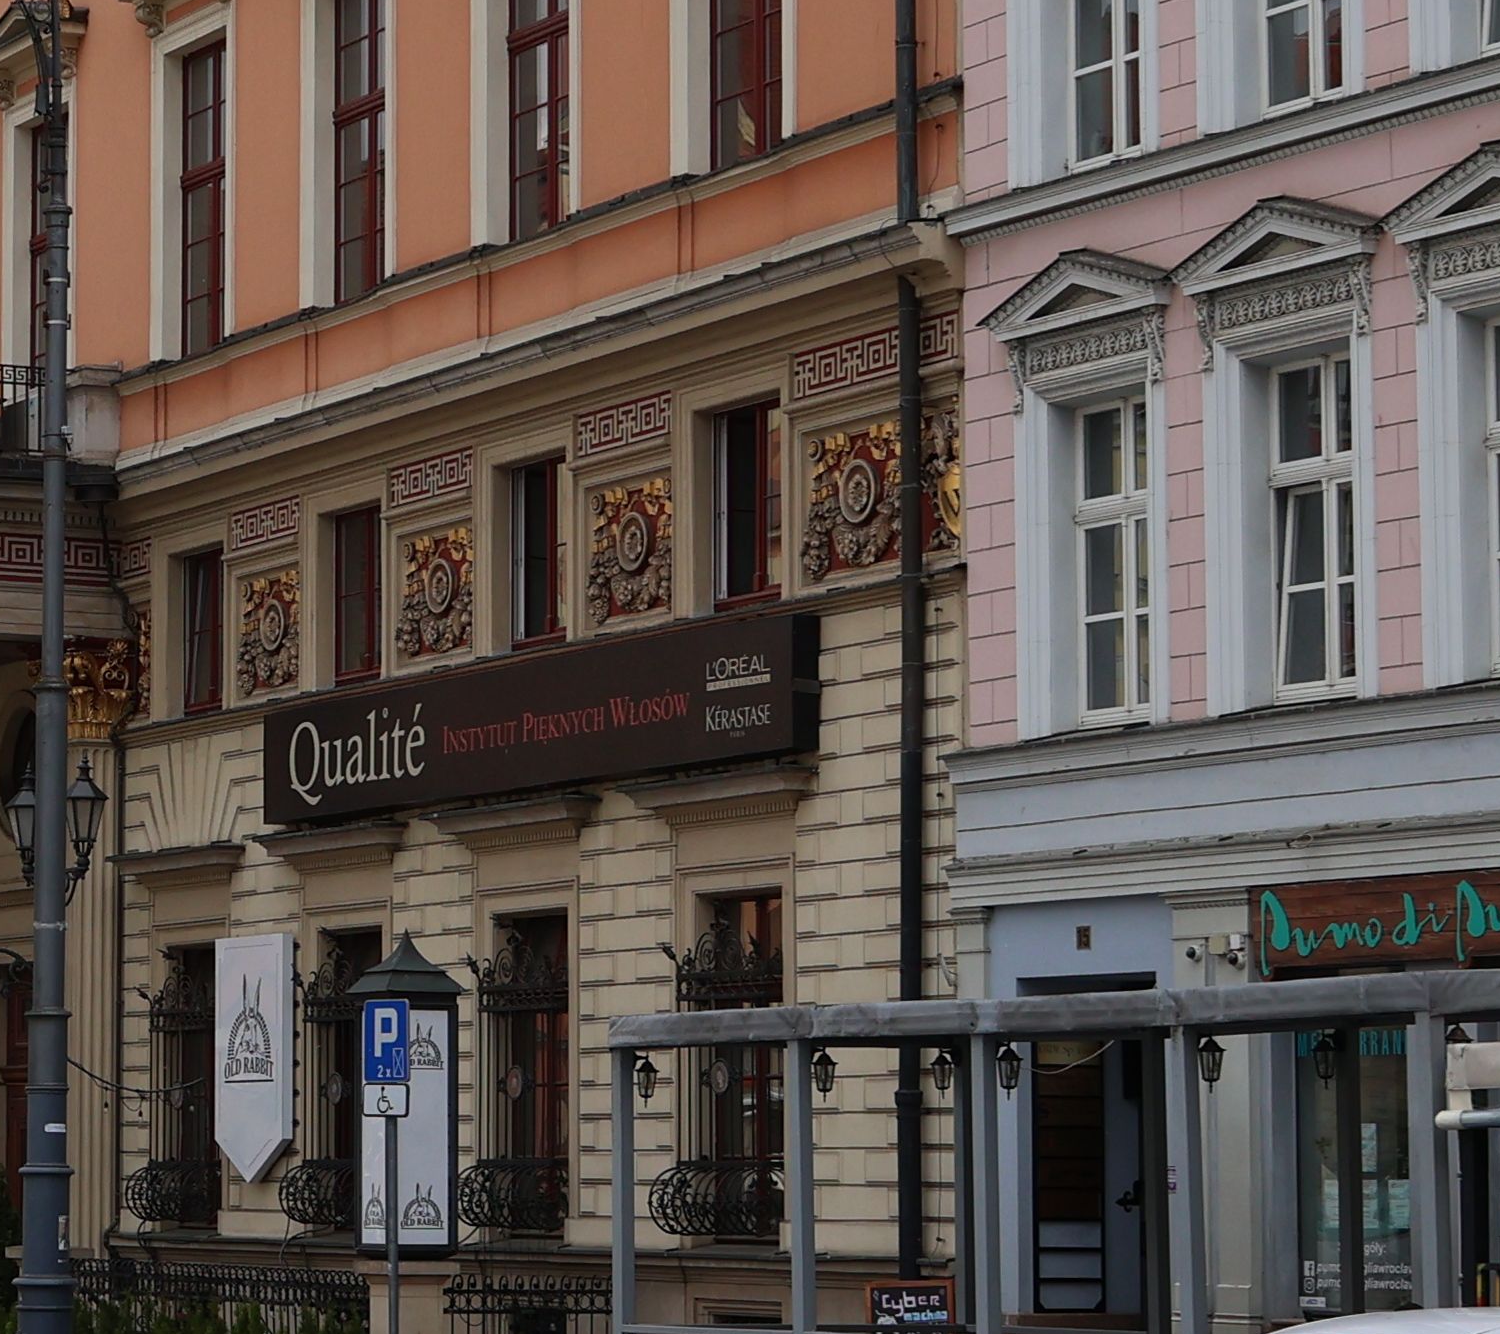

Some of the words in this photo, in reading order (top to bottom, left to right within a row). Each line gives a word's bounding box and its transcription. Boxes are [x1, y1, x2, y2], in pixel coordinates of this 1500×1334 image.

[706, 654, 771, 680] L'ORÉAL
[443, 721, 517, 754] INSTYTUT
[523, 706, 604, 744] PIĘKNYCH
[609, 689, 690, 729] WŁOSÓW
[706, 704, 771, 732] KÉRASTASE
[289, 703, 426, 805] Qualité
[1260, 890, 1384, 976] Pumo
[1392, 892, 1451, 946] di
[374, 1008, 398, 1057] P
[224, 1058, 242, 1079] OLD
[243, 1056, 274, 1079] RABBIT
[377, 1066, 384, 1078] 2
[417, 1058, 444, 1067] RABBIT
[400, 1219, 415, 1228] OLD
[417, 1219, 444, 1228] RABBIT
